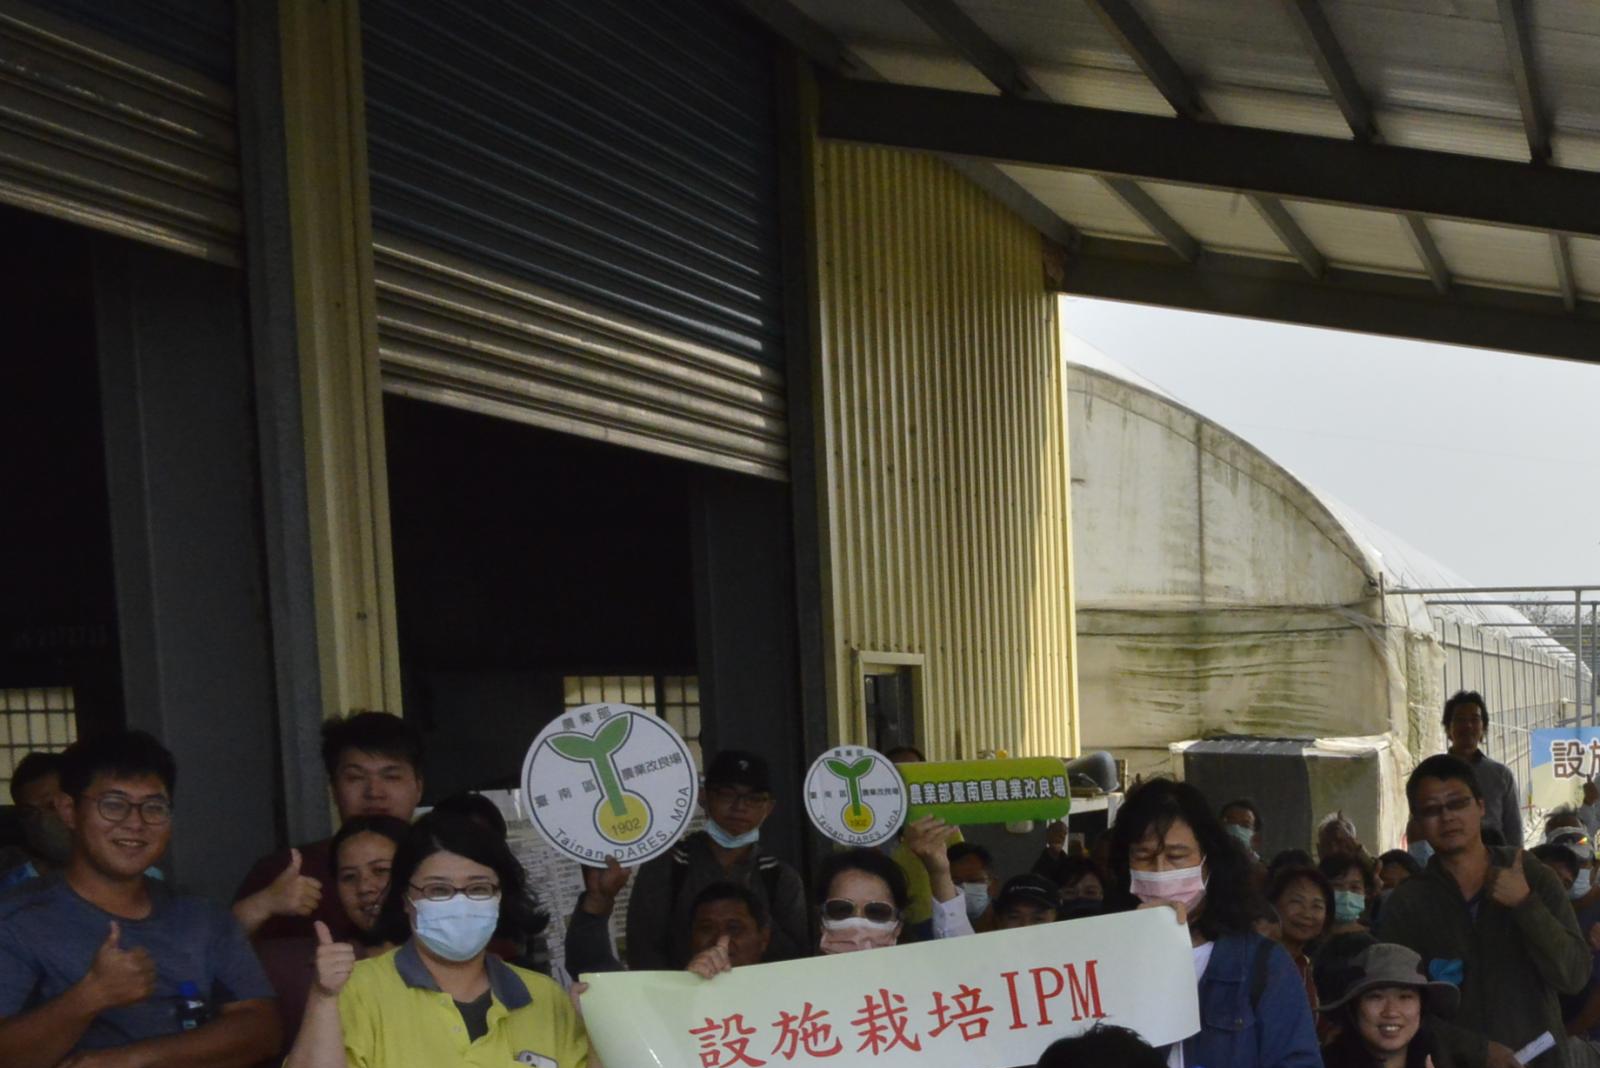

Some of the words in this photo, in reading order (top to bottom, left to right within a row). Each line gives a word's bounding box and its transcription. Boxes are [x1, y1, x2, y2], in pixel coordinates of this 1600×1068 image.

[561, 706, 612, 730] 農業部
[621, 752, 682, 781] 農業改良場
[909, 776, 1067, 805] 農業部臺南區農業改良場
[555, 827, 604, 859] Tainan
[671, 786, 690, 822] MOA
[611, 817, 641, 836] 1902
